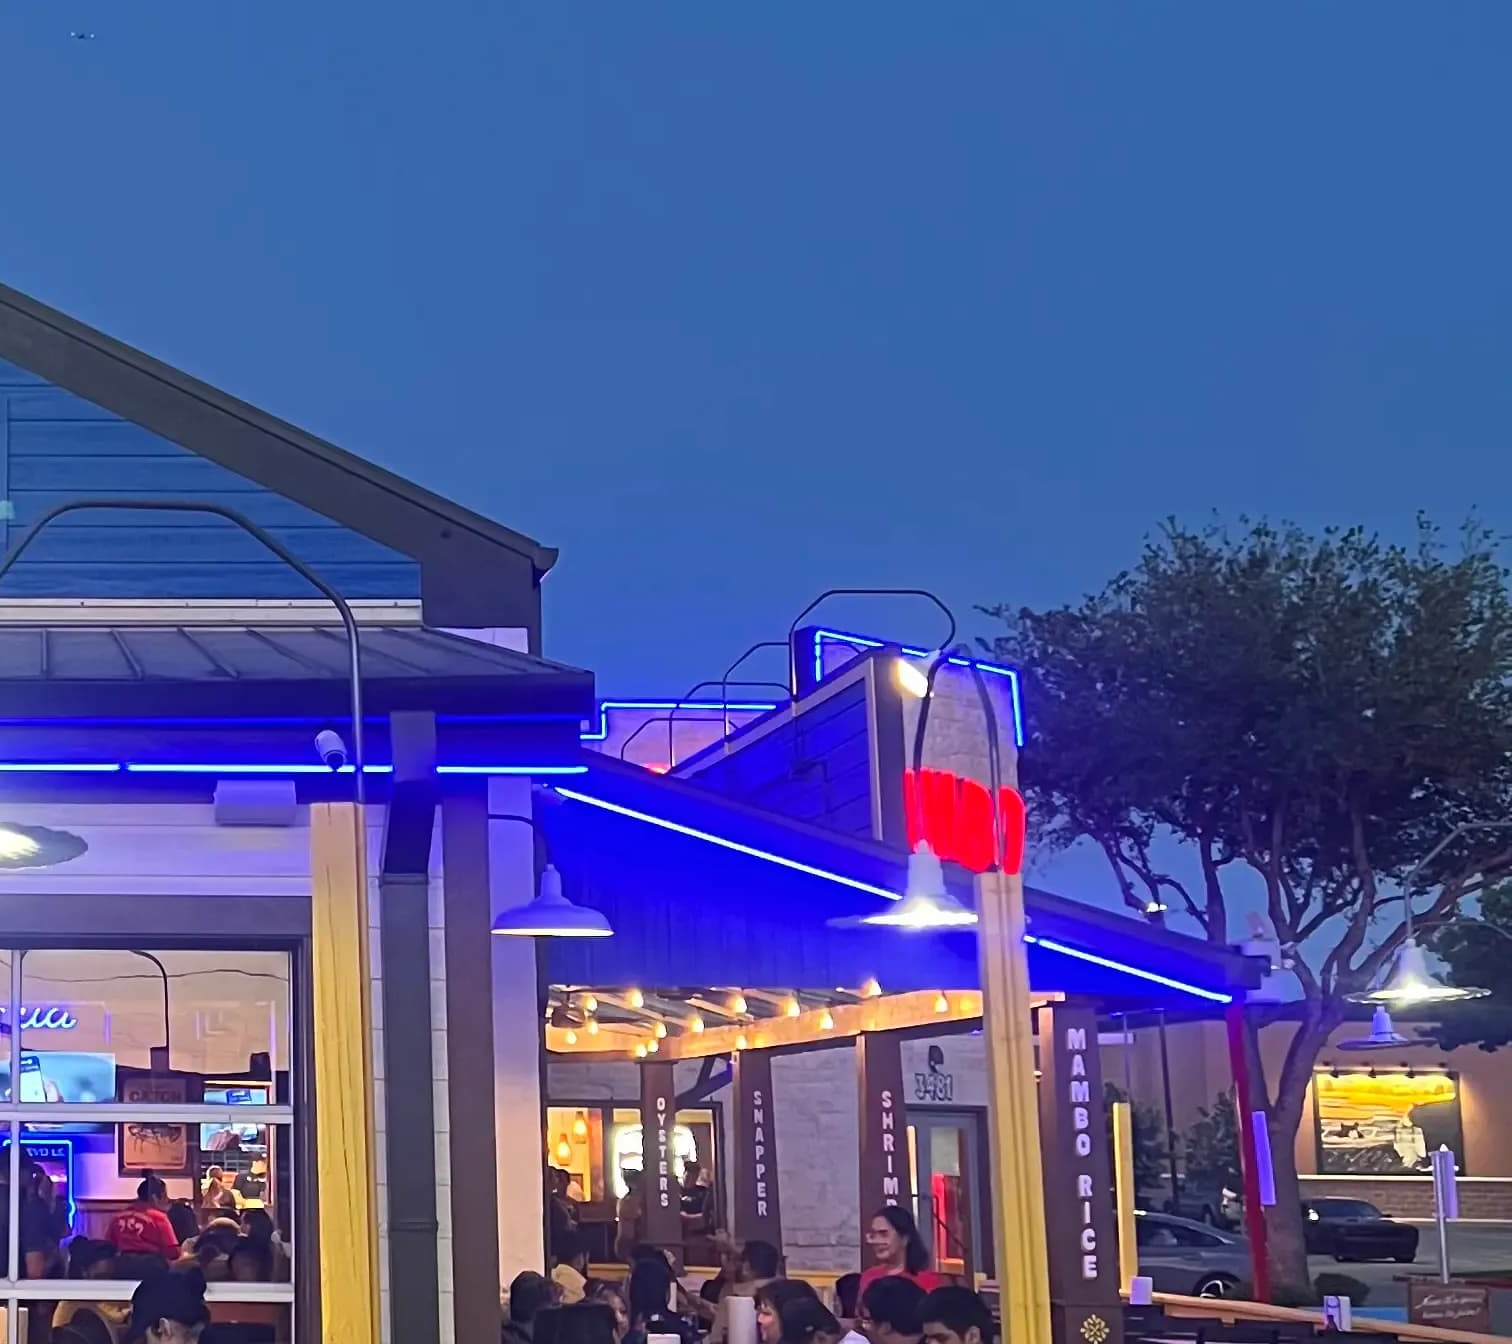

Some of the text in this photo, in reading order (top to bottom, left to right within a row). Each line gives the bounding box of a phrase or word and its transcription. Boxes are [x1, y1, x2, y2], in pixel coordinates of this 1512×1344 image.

[914, 1072, 954, 1102] 3481
[656, 1096, 669, 1207] OYSTERS
[751, 1089, 769, 1217] SNAPPER
[1066, 1027, 1099, 1281] MAMBO RICE
